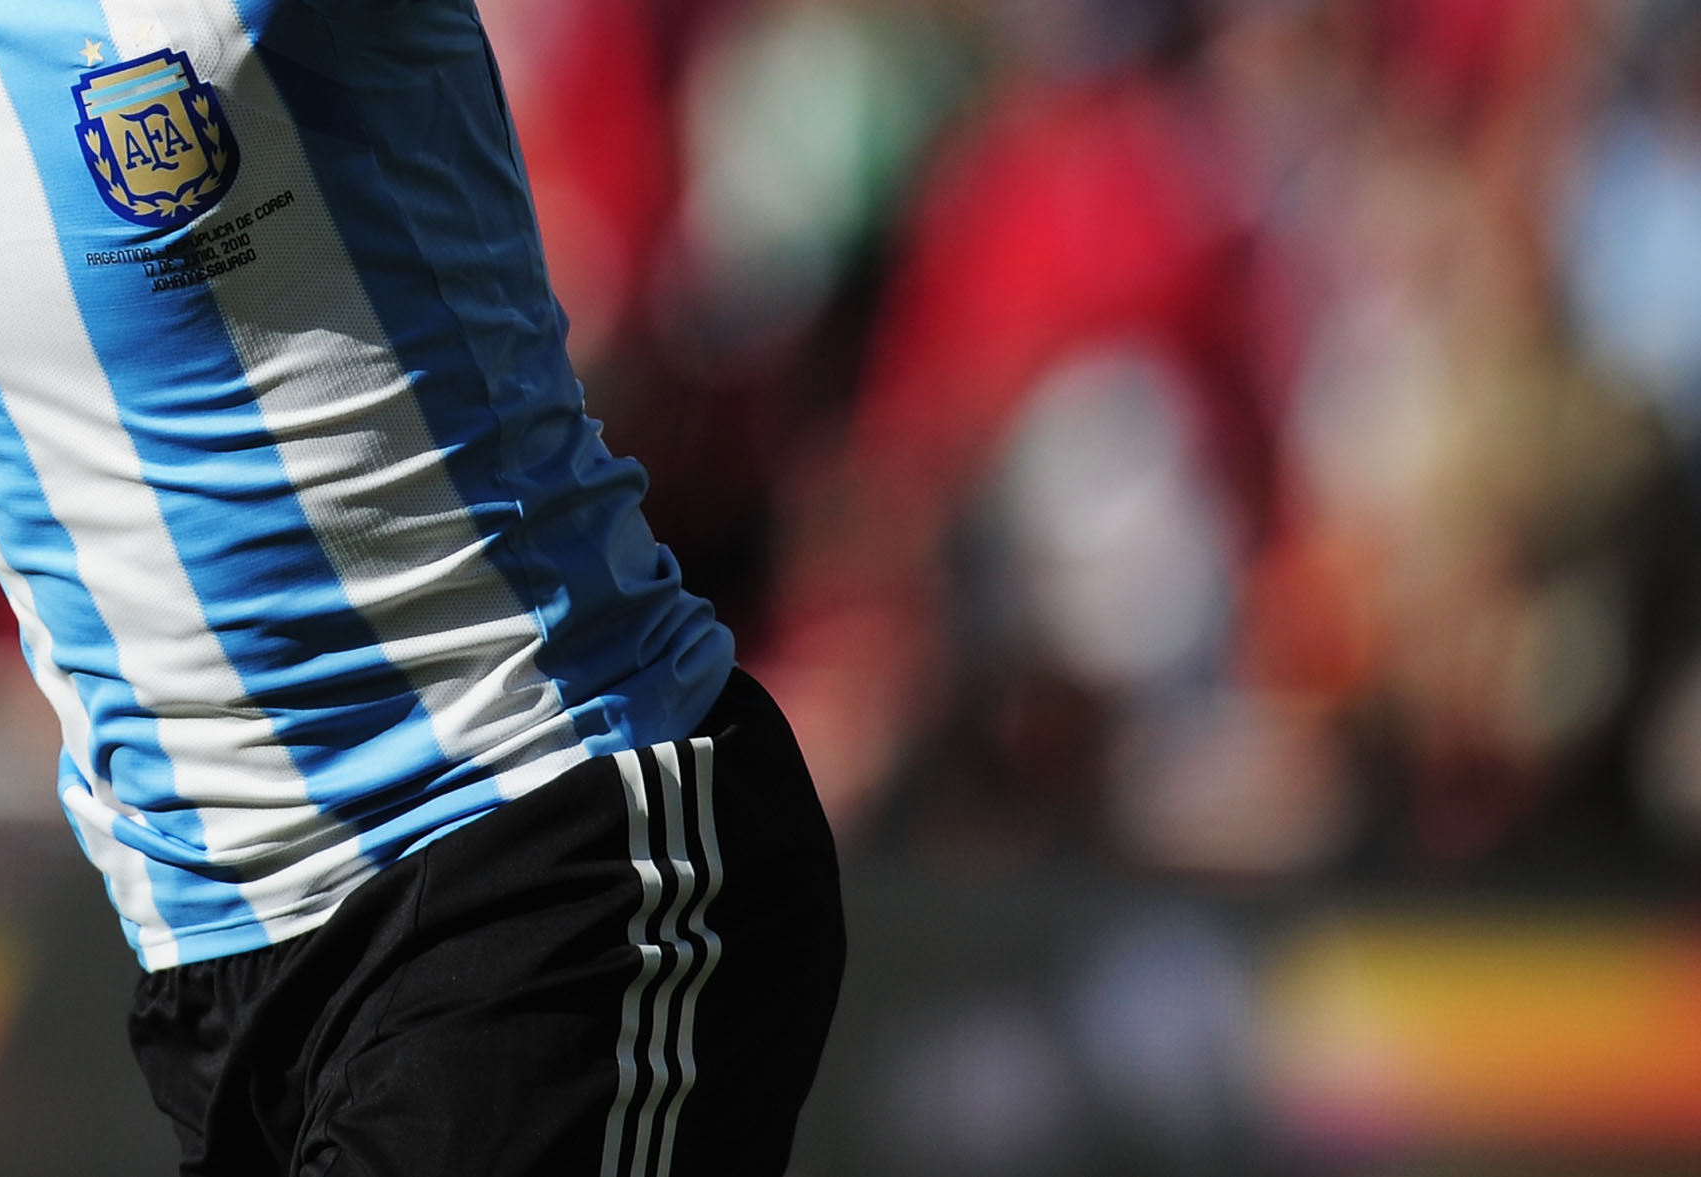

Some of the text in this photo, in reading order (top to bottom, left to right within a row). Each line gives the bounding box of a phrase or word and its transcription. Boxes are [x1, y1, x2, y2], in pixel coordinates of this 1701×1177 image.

[119, 104, 193, 171] AFA
[86, 248, 151, 266] ARGENTINA
[236, 214, 253, 231] DE
[255, 190, 295, 221] COREA
[143, 263, 154, 278] 17
[159, 260, 175, 274] DE
[221, 233, 251, 254] 2010
[152, 249, 257, 293] JOHANNESBURGO
